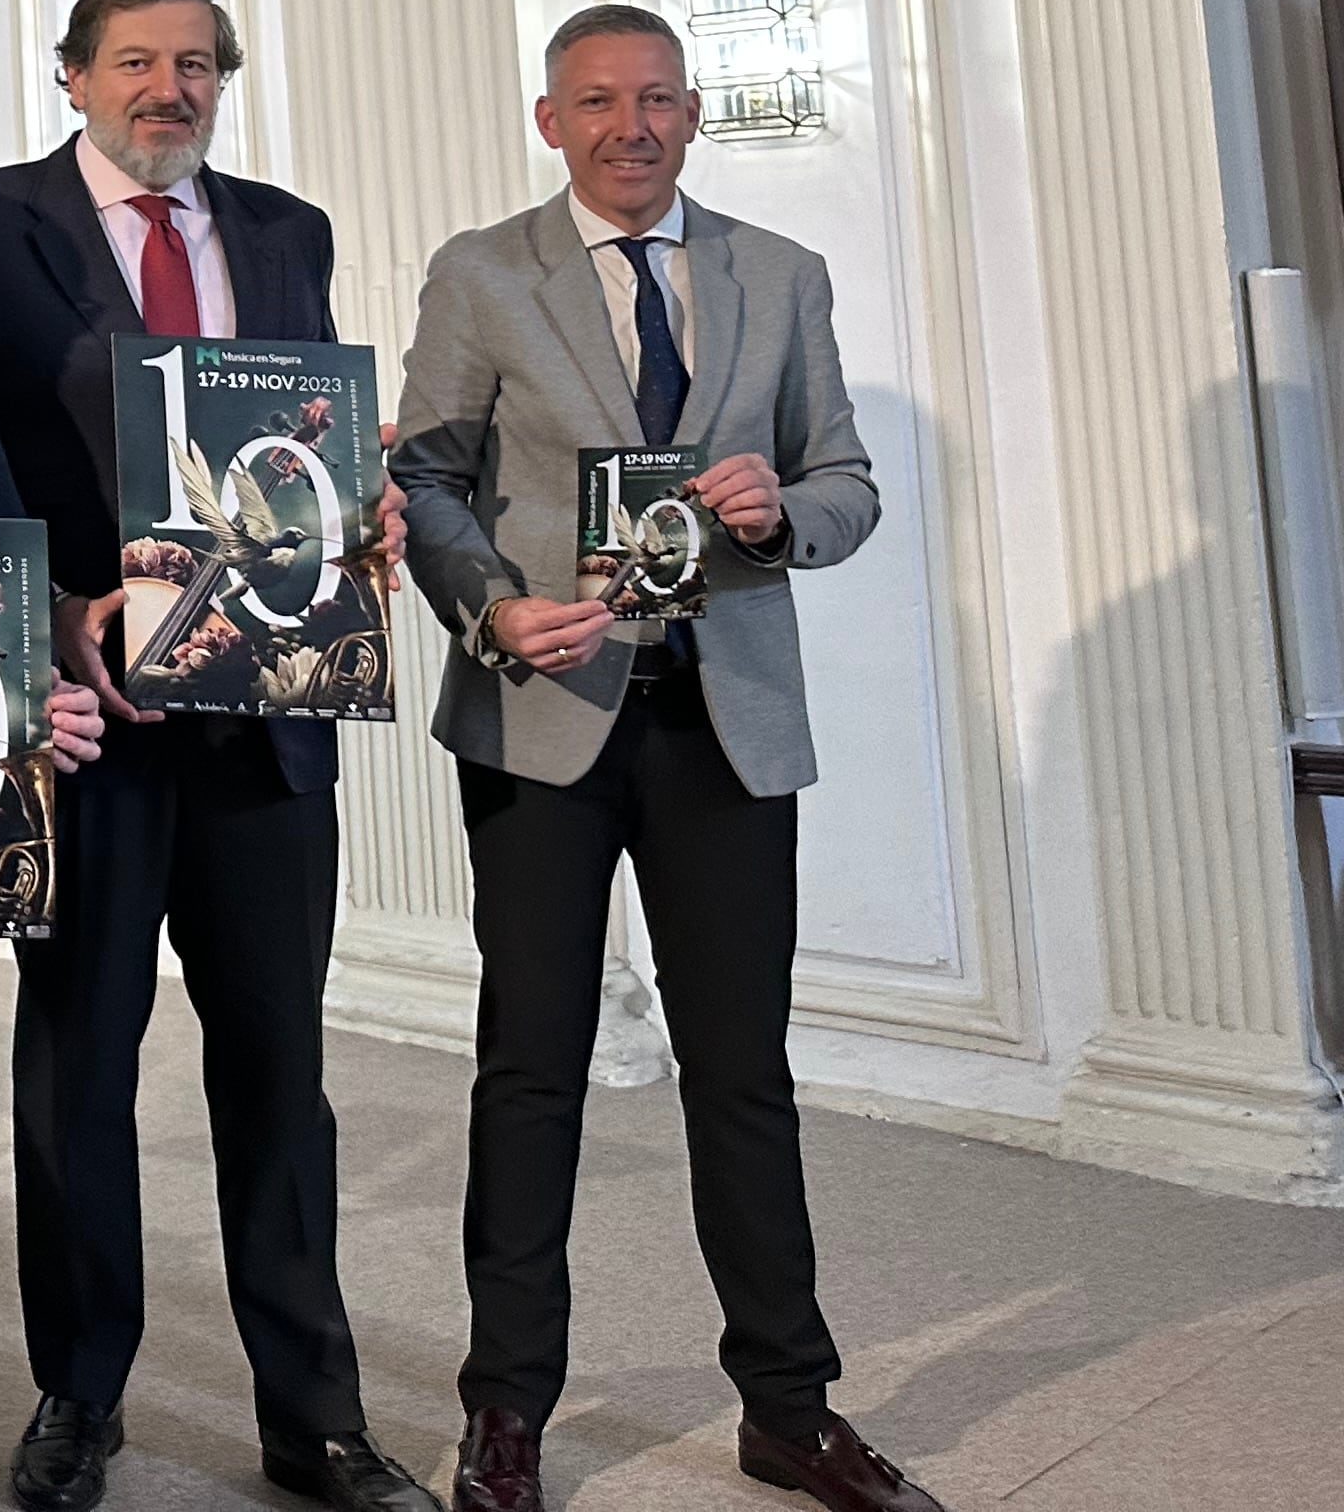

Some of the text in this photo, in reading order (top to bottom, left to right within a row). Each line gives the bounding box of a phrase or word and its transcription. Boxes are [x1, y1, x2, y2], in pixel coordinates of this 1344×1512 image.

[256, 353, 268, 363] en
[268, 353, 302, 366] Segura
[197, 371, 342, 393] 17-19 NOV 2023
[624, 454, 654, 465] 17-19
[655, 453, 681, 464] NOV
